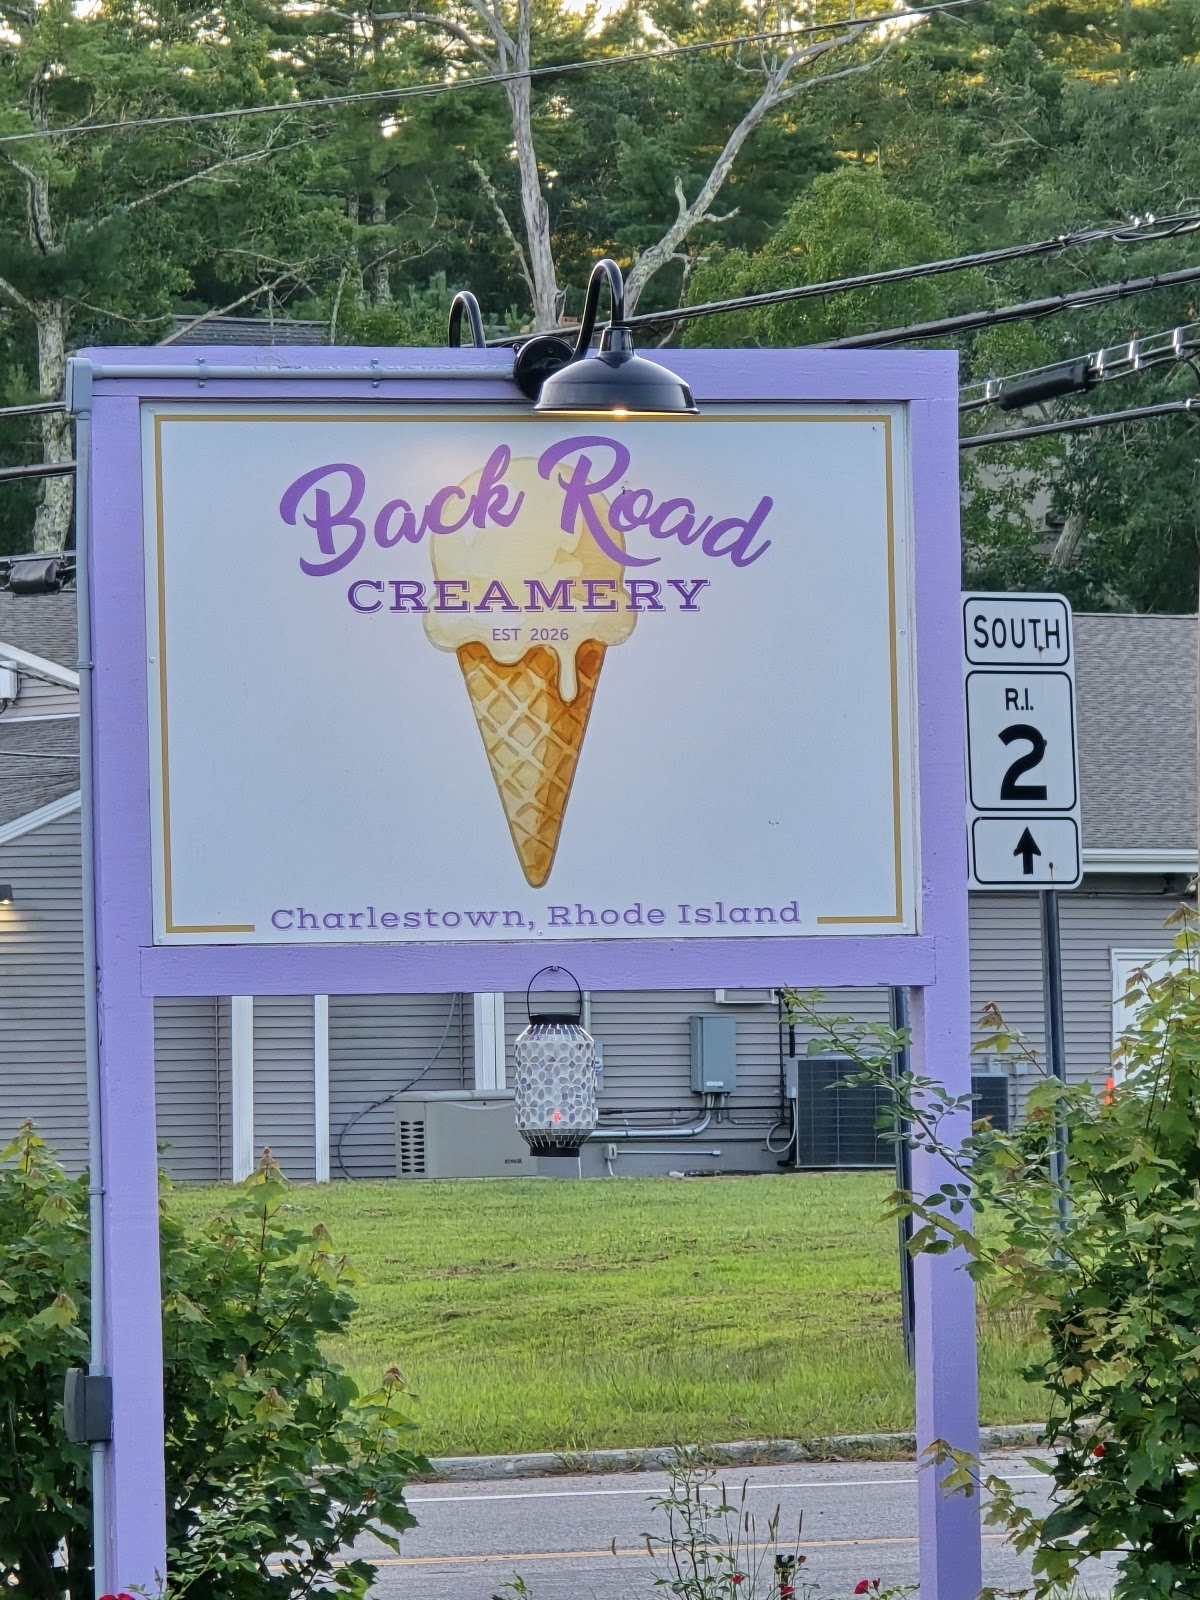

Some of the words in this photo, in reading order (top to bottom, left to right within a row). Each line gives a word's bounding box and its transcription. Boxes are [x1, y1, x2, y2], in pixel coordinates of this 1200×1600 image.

[280, 444, 523, 576] Back
[538, 436, 773, 567] Road
[347, 579, 710, 613] CREAMERY
[492, 628, 521, 641] EST
[530, 628, 569, 641] 2026
[974, 615, 1061, 649] SOUTH
[1005, 688, 1034, 711] R.I.
[998, 724, 1047, 800] 2
[271, 908, 535, 931] Charlestown,
[547, 902, 665, 927] Rhode
[677, 901, 801, 925] Island
